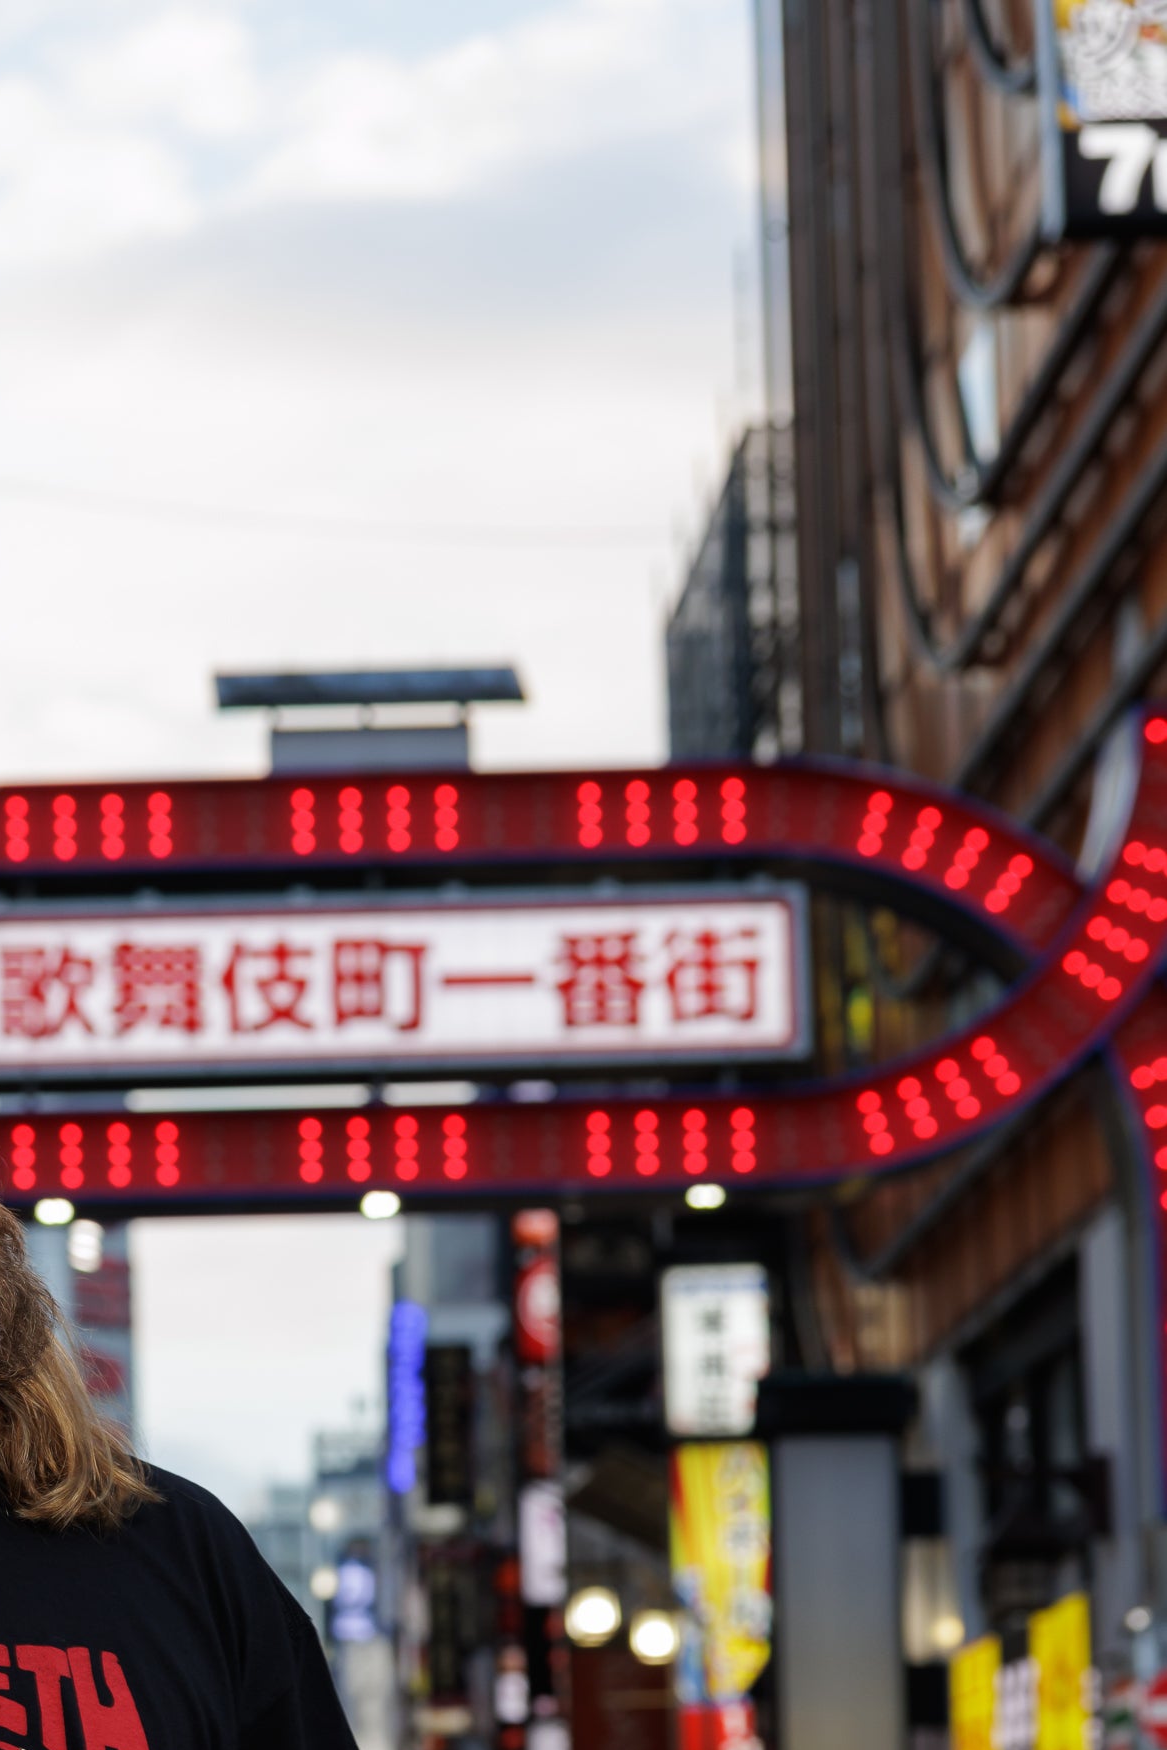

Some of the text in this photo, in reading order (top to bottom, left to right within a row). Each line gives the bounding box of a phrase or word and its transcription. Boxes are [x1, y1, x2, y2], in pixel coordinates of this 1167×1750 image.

[0, 926, 762, 1038] 歌舞伎町一番街
